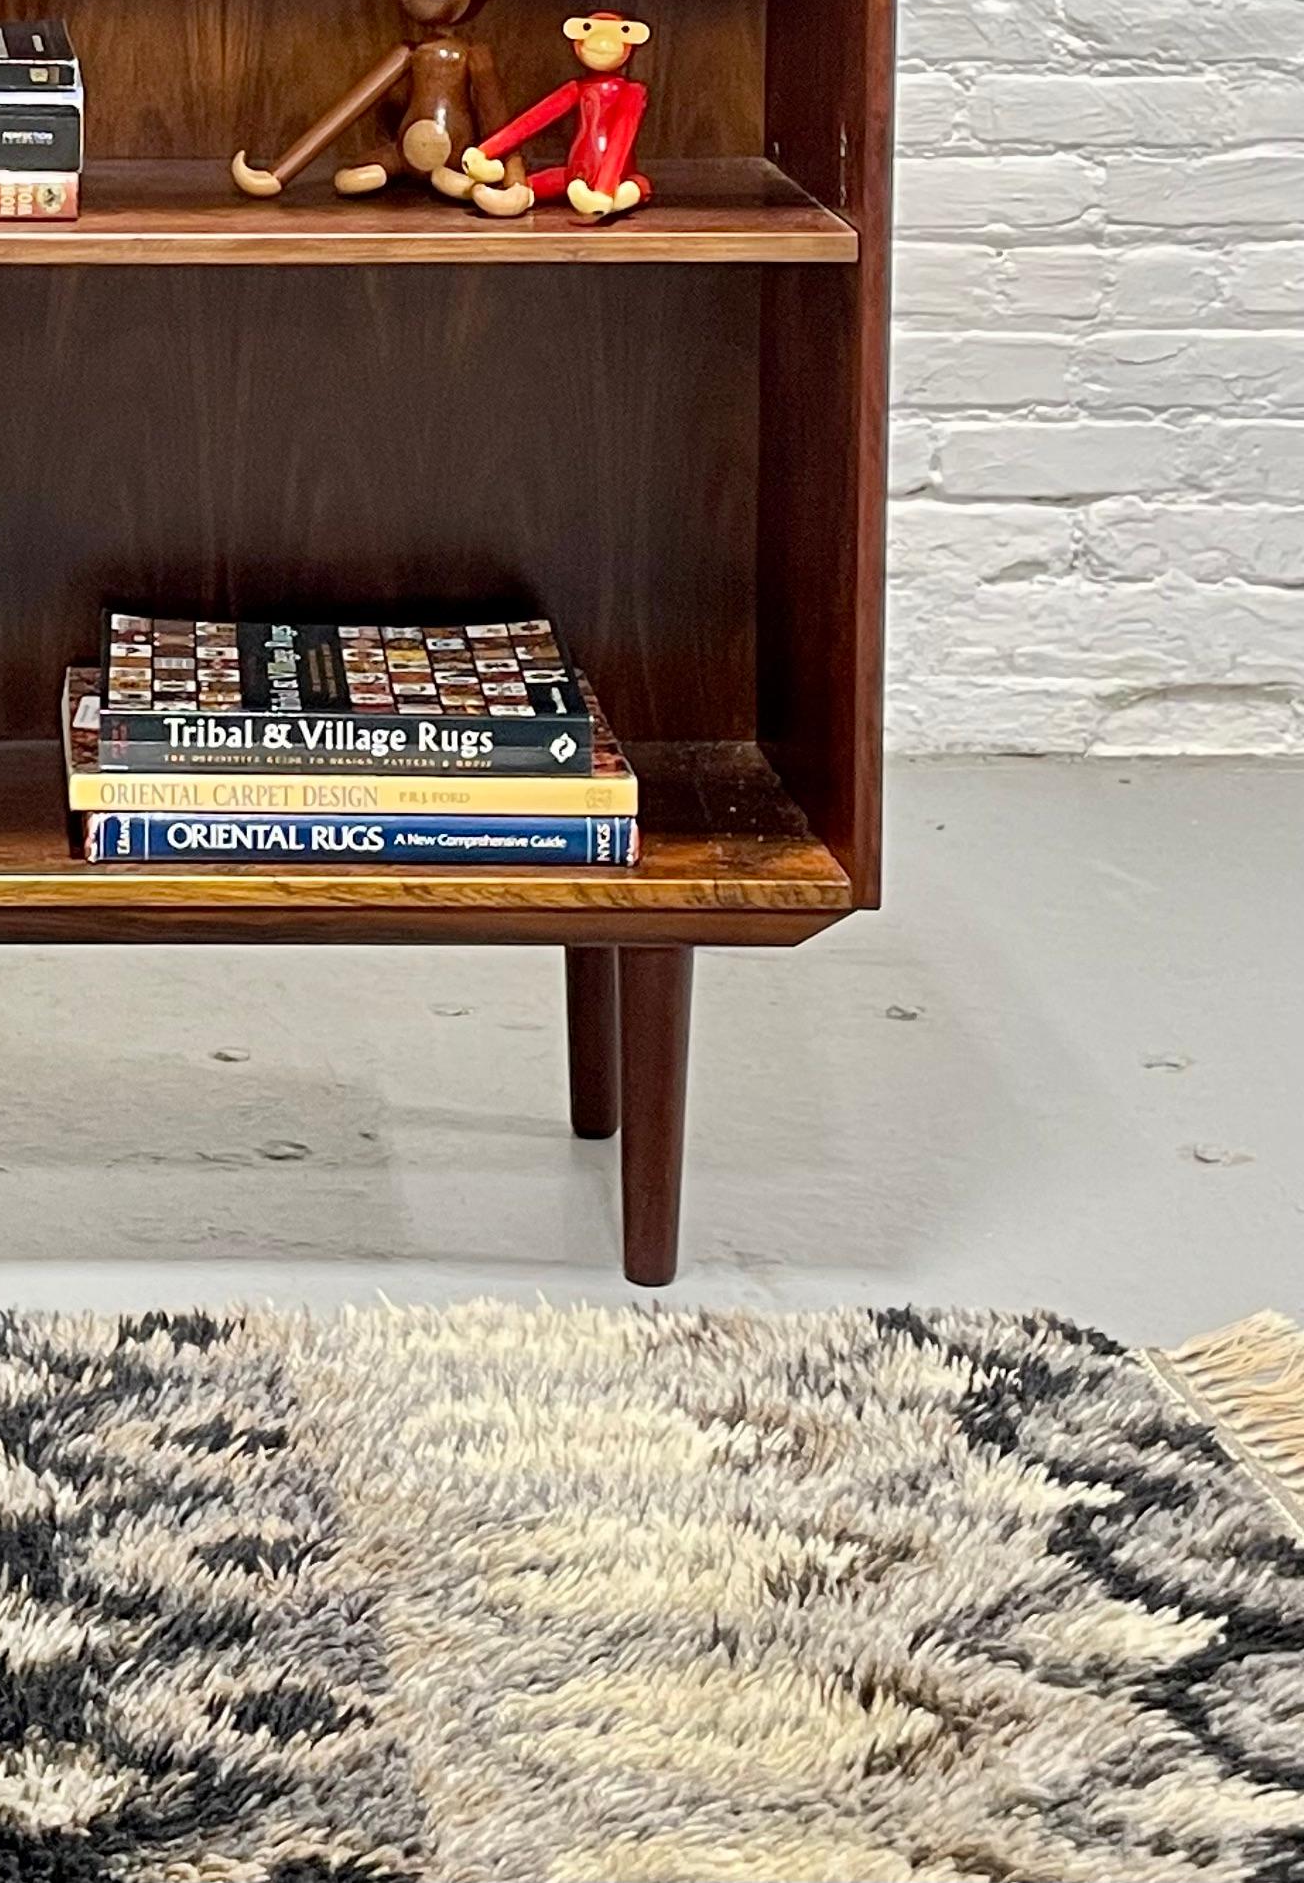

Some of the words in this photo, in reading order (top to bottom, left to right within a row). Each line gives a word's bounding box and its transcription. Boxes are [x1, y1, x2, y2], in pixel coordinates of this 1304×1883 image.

[163, 718, 253, 748] Tribal
[262, 723, 293, 749] &
[298, 720, 407, 757] Village
[418, 721, 494, 759] Rugs
[100, 782, 205, 806] ORIENTAL
[212, 783, 294, 807] CARPET
[302, 785, 378, 807] DESIGN
[432, 791, 470, 804] FORD
[167, 823, 304, 850] ORIENTAL
[312, 825, 384, 851] RUGS
[394, 833, 405, 845] A
[407, 833, 438, 846] New
[438, 834, 528, 849] Comprehensive
[530, 834, 568, 848] Guide
